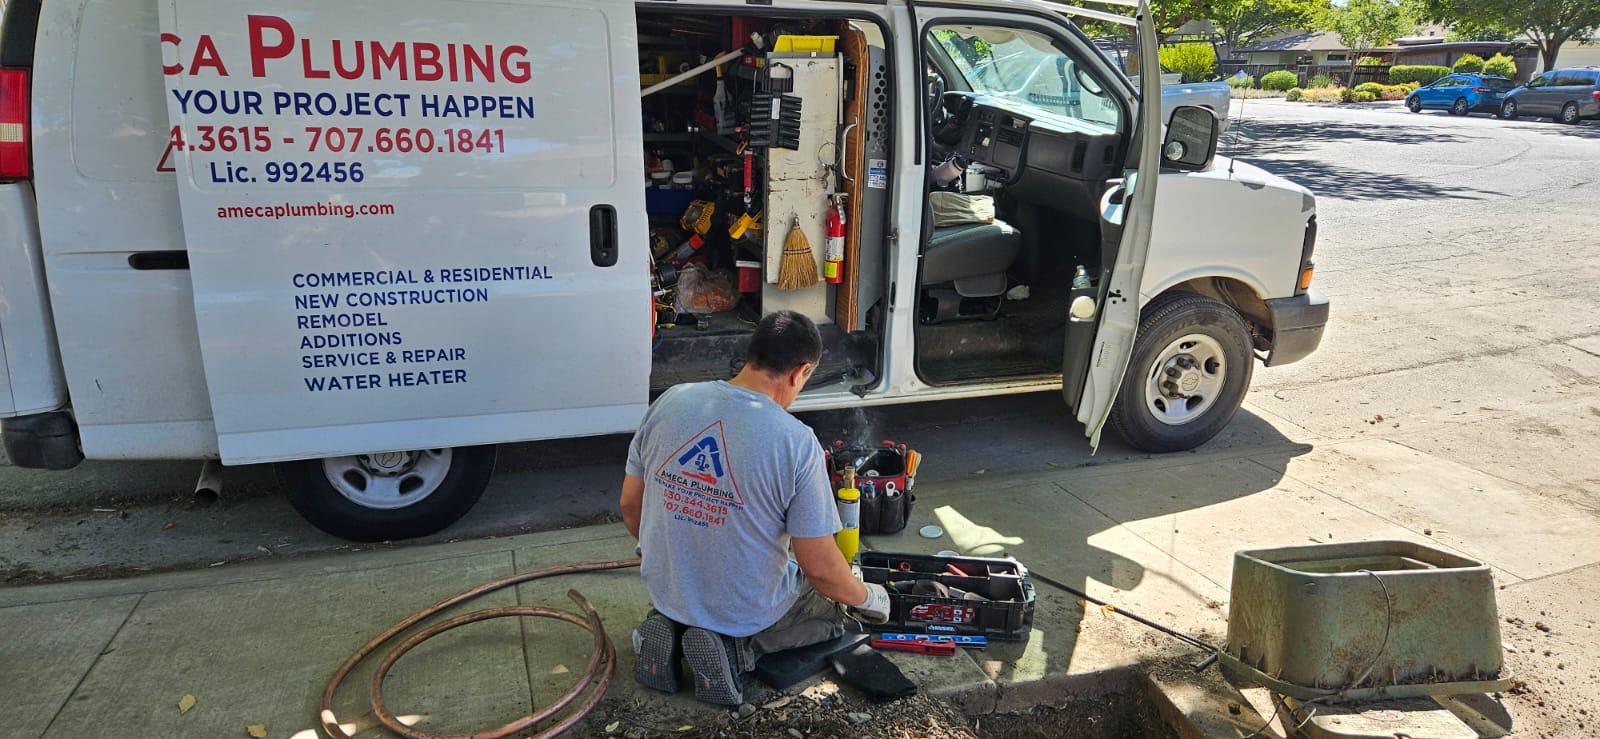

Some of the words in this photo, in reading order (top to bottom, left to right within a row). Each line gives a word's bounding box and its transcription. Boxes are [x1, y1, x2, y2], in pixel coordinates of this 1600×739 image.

[248, 15, 532, 84] PLUMBING
[172, 90, 263, 115] YOUR
[274, 92, 411, 117] PROJECT
[421, 94, 534, 118] HAPPEN
[305, 127, 505, 153] 707.660.1841
[210, 161, 256, 183] Lic.
[265, 162, 364, 183] 992456
[217, 201, 394, 220] amecaplumbing.com
[292, 270, 418, 288] COMMERCIAL
[424, 269, 434, 284] &
[440, 266, 552, 282] RESIDENTIAL
[294, 294, 340, 310] NEW
[346, 288, 488, 307] CONSTRUCTION
[297, 312, 388, 329] REMODEL
[300, 332, 402, 350] ADDITIONS
[302, 352, 380, 368] SERVICE
[386, 352, 397, 364] &
[402, 348, 466, 364] REPAIR
[304, 374, 382, 392] WATER
[388, 369, 467, 388] HEATER
[661, 470, 688, 487] AMECA
[690, 481, 734, 499] PLUMBING
